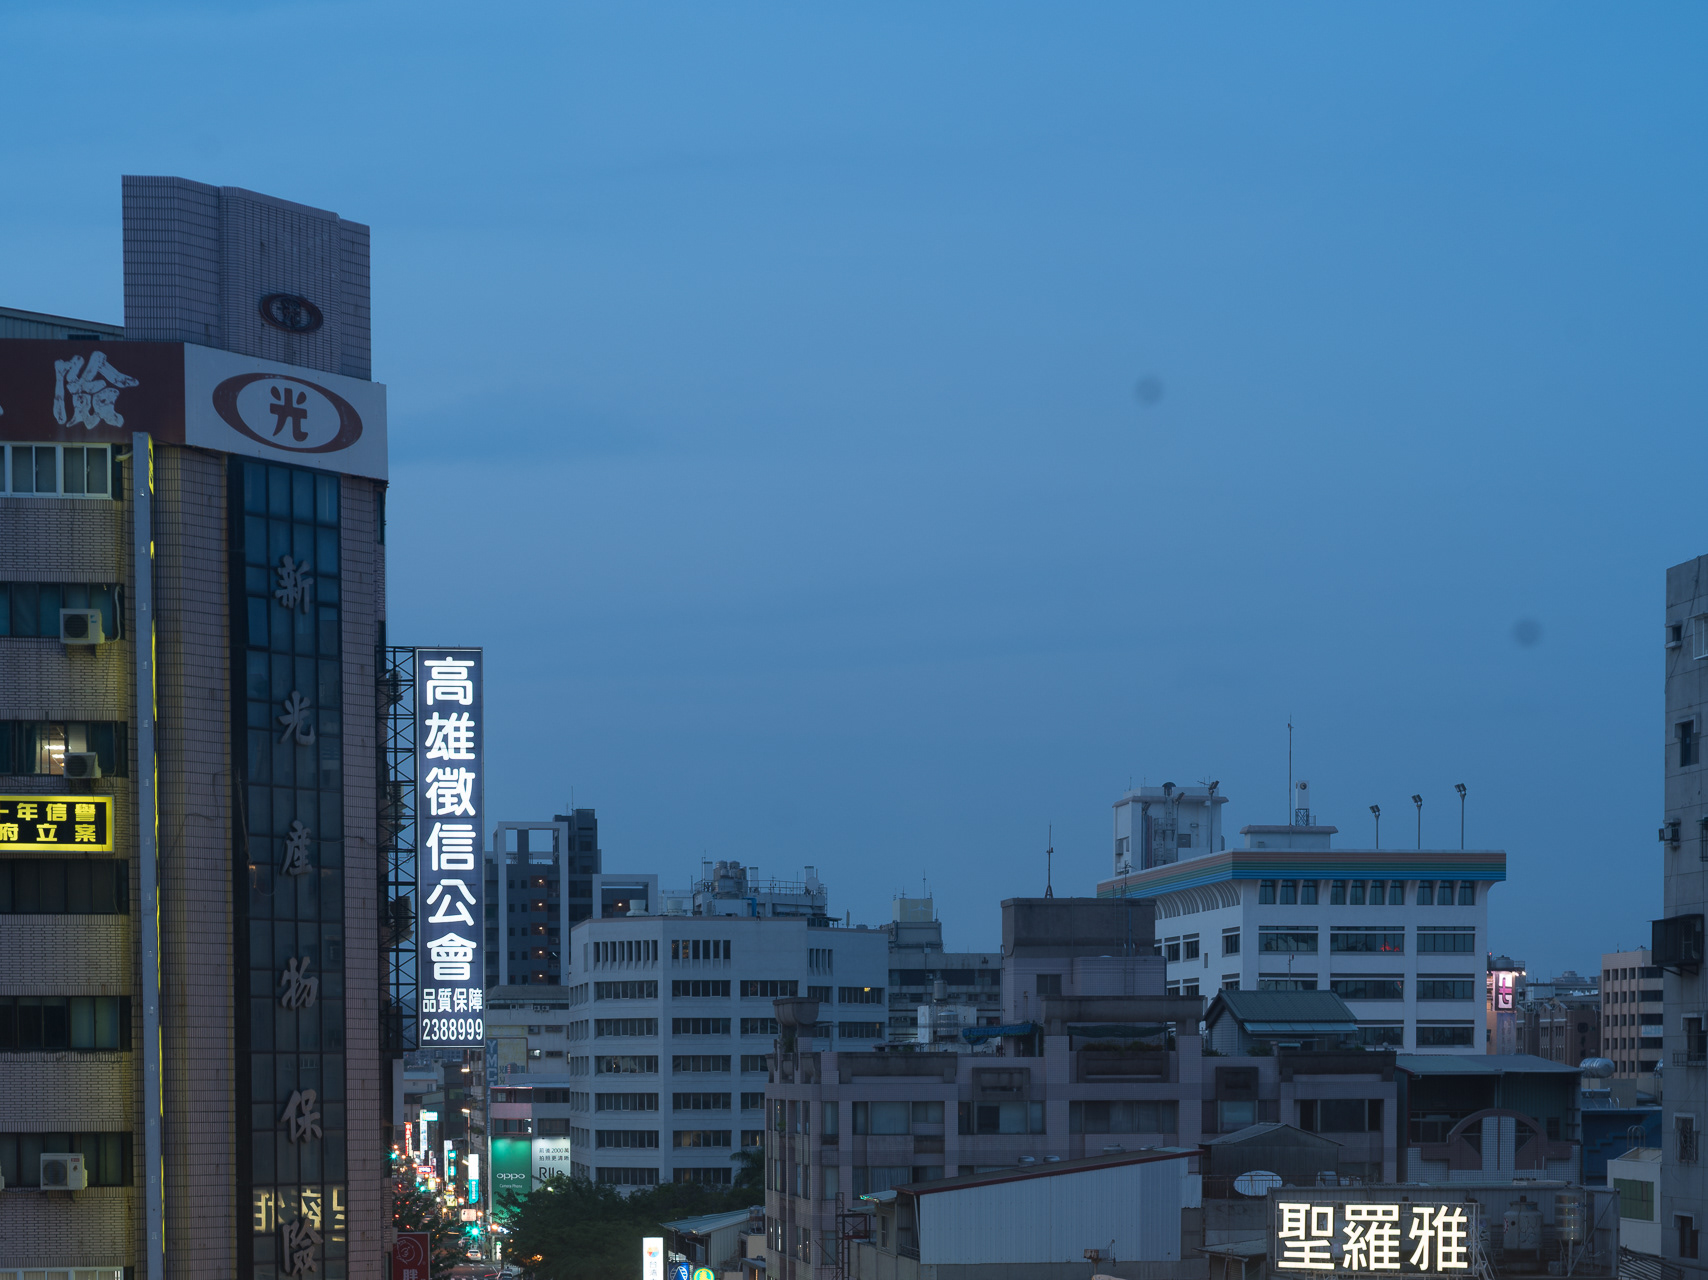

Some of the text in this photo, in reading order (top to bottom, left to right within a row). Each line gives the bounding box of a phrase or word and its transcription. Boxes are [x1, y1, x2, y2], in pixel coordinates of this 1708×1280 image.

[269, 385, 309, 442] 光
[0, 803, 96, 822] 年信譽
[424, 657, 477, 981] 高雄徵信公會
[423, 988, 483, 1014] 品質保障
[423, 1018, 484, 1041] 2388999
[1278, 1202, 1468, 1272] 聖羅雅
